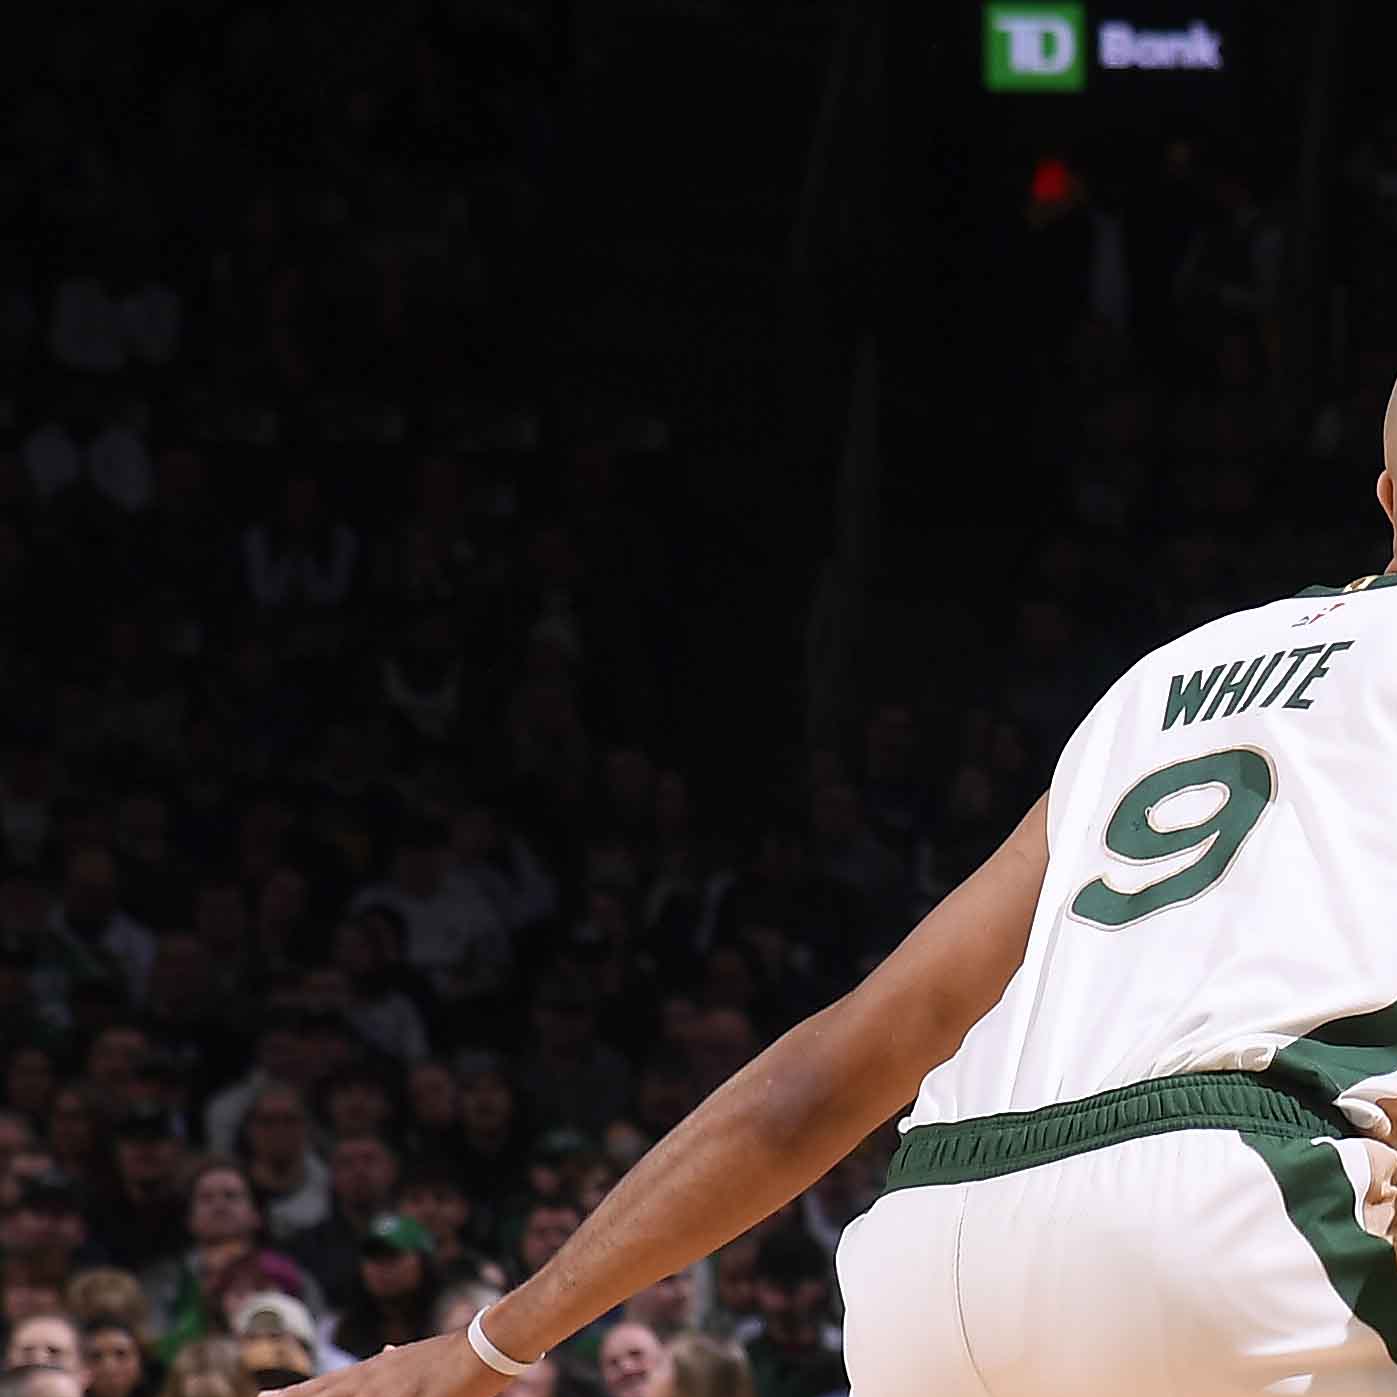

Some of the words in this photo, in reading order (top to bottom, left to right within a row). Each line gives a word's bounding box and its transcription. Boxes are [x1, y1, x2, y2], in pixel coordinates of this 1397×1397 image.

[991, 12, 1078, 75] TD
[1098, 18, 1224, 70] Bank
[1162, 640, 1355, 731] WHITE
[1066, 744, 1279, 931] 9
